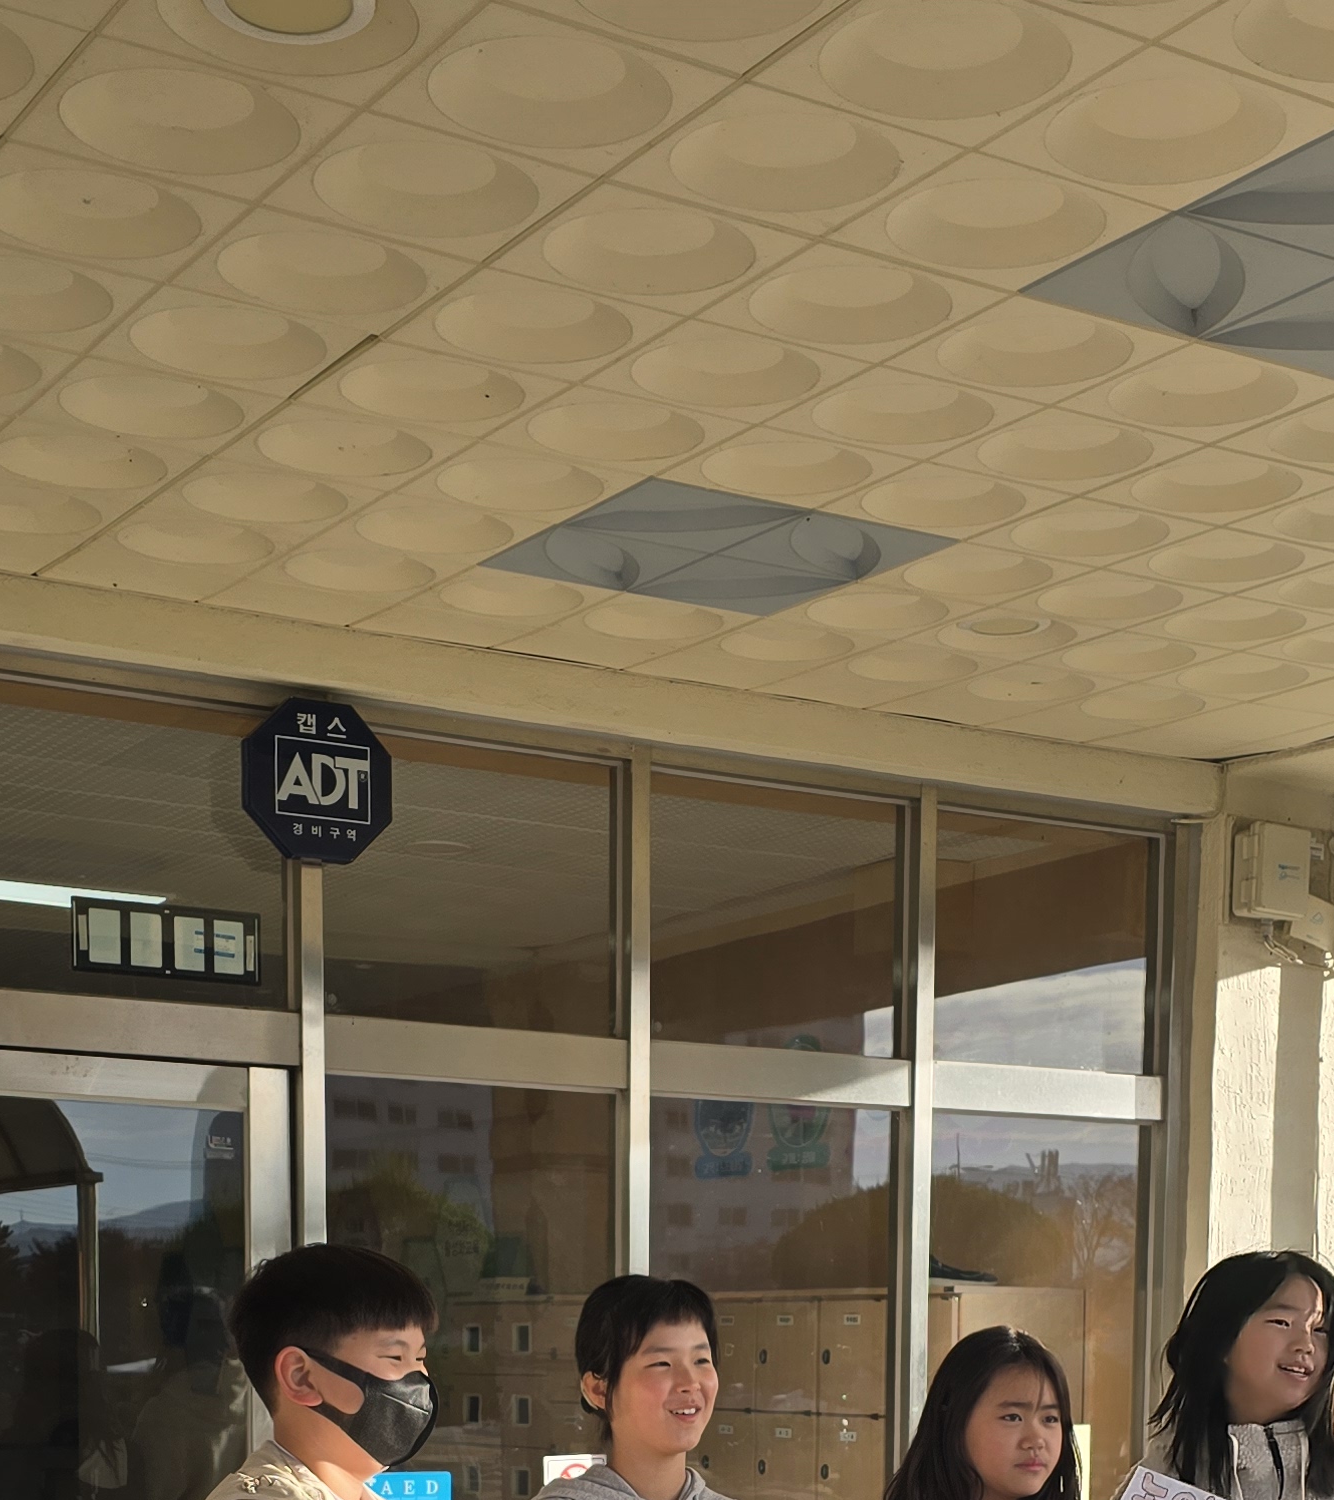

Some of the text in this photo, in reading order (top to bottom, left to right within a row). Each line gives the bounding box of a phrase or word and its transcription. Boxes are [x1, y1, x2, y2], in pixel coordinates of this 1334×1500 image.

[296, 713, 347, 739] 캡스
[277, 752, 368, 810] ADT
[381, 1480, 439, 1495] AED
